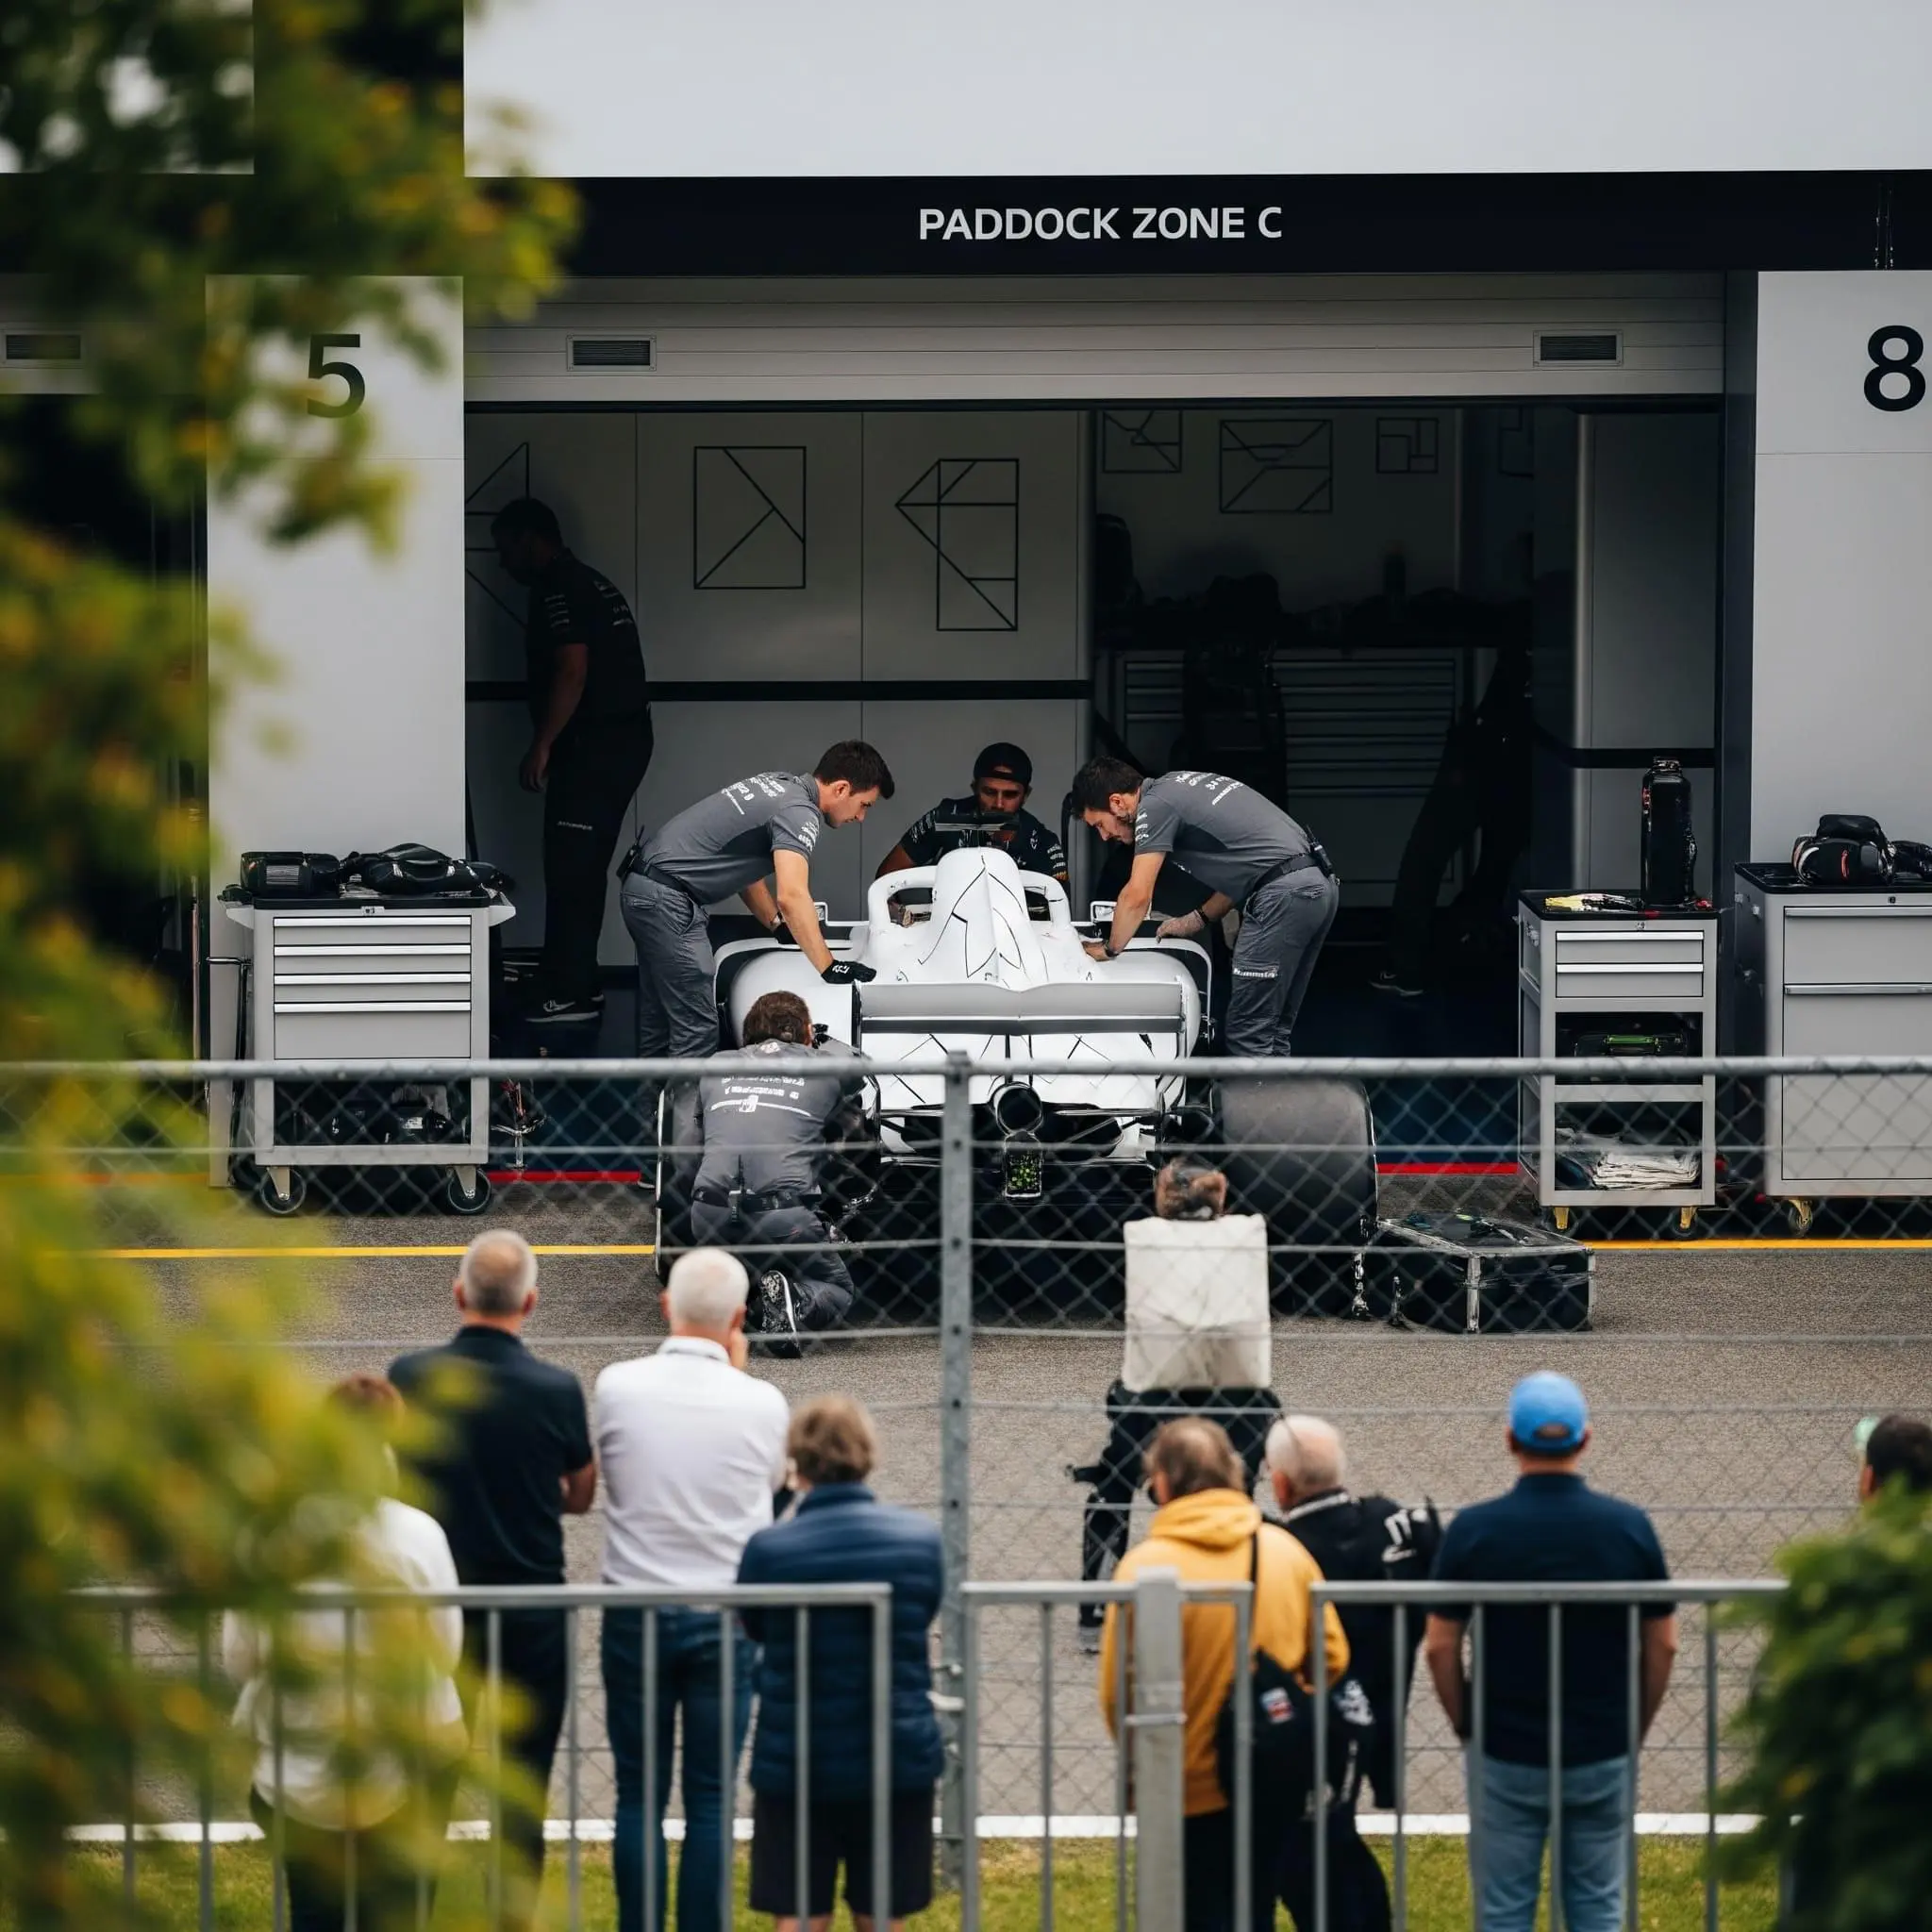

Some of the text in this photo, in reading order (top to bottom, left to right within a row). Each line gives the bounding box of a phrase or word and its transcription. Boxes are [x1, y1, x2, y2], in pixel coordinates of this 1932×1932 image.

[919, 206, 1283, 242] PADDOCK ZONE C
[307, 333, 366, 419] 5
[1863, 325, 1926, 412] 8
